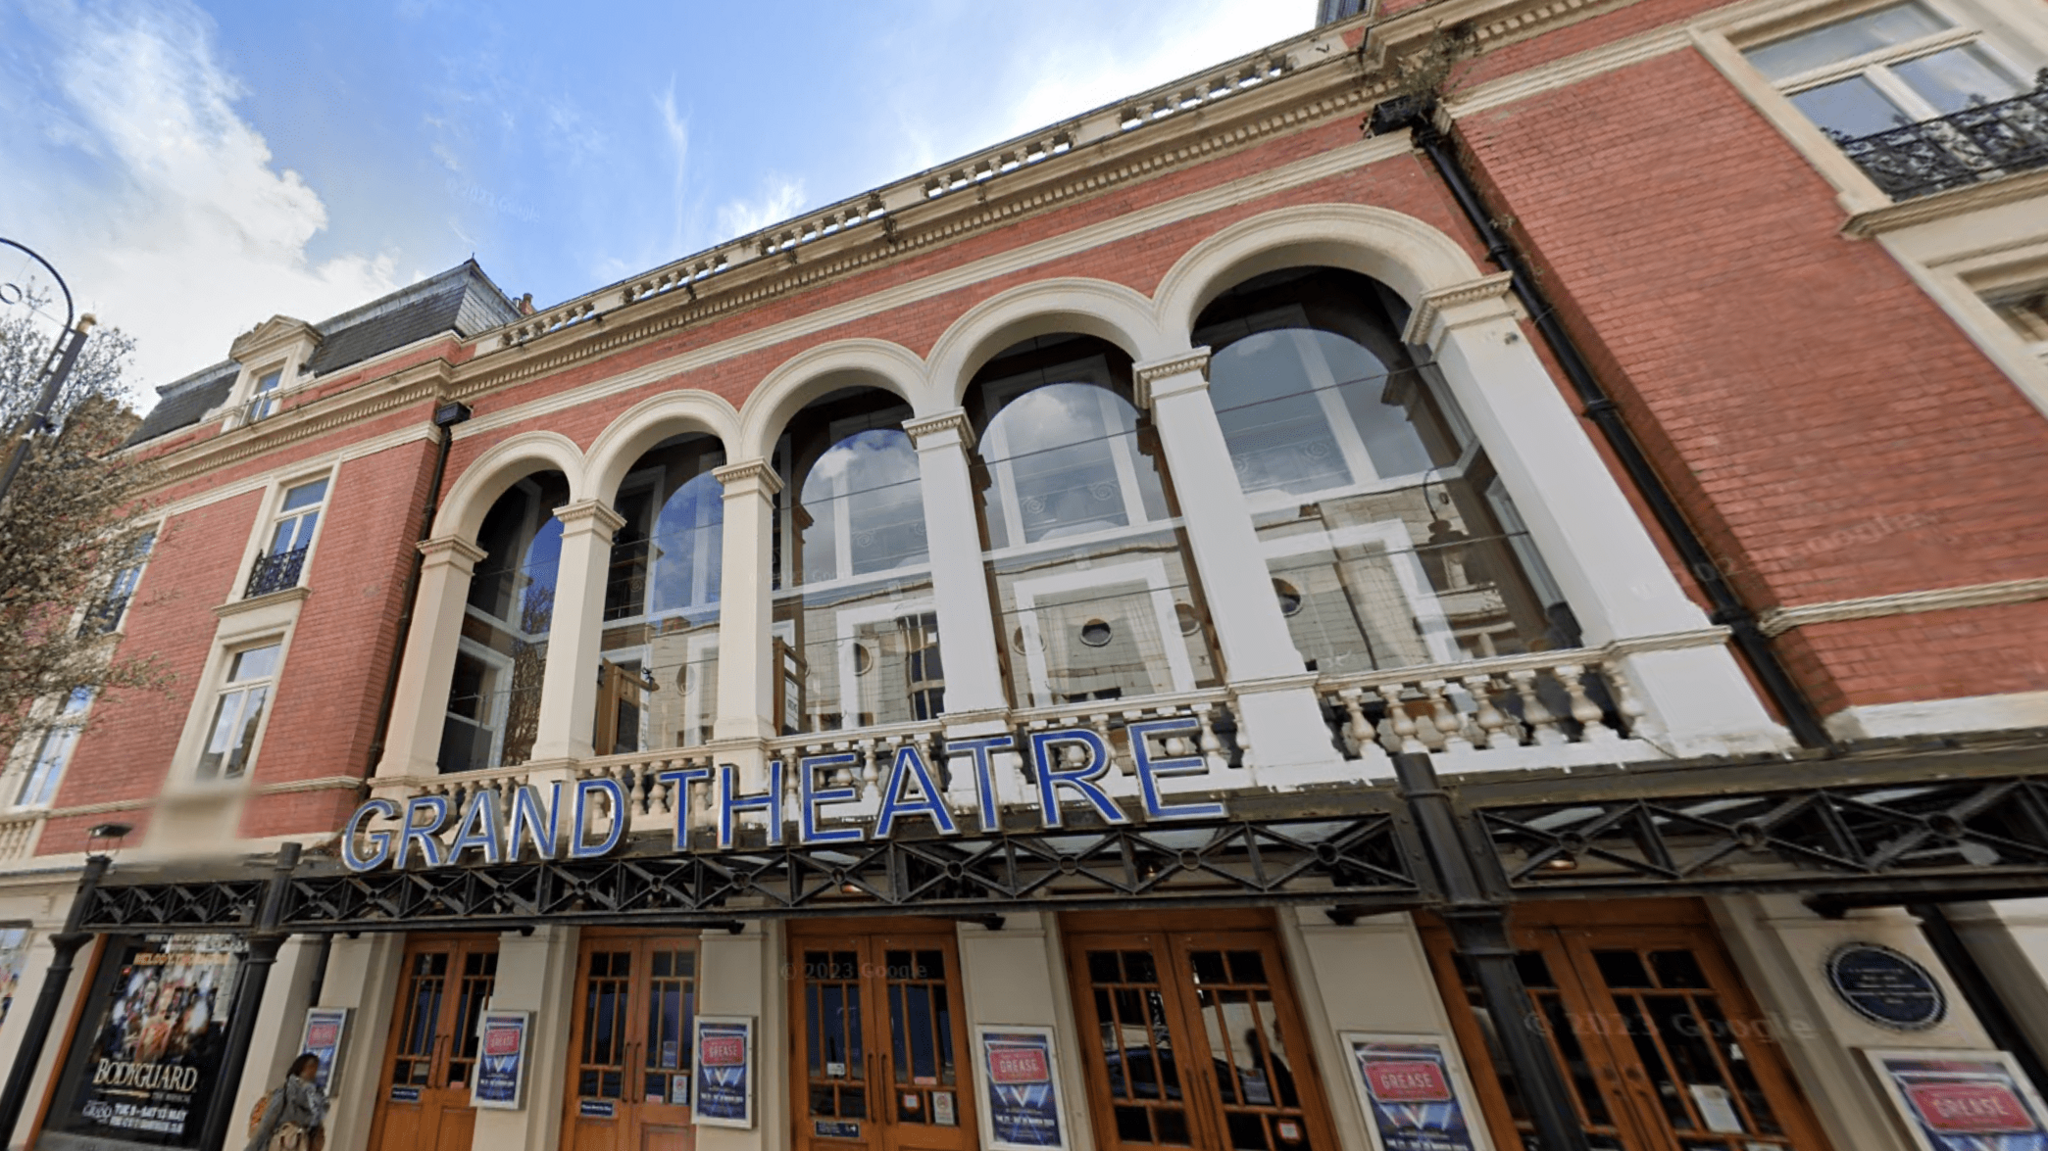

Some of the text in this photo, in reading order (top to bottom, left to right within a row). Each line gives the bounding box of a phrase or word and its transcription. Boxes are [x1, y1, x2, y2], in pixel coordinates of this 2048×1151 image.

[341, 717, 1229, 872] GRAND THEATRE
[93, 1059, 197, 1091] BODYGUARD
[999, 1058, 1038, 1073] GREASE
[1381, 1074, 1434, 1089] GREASE
